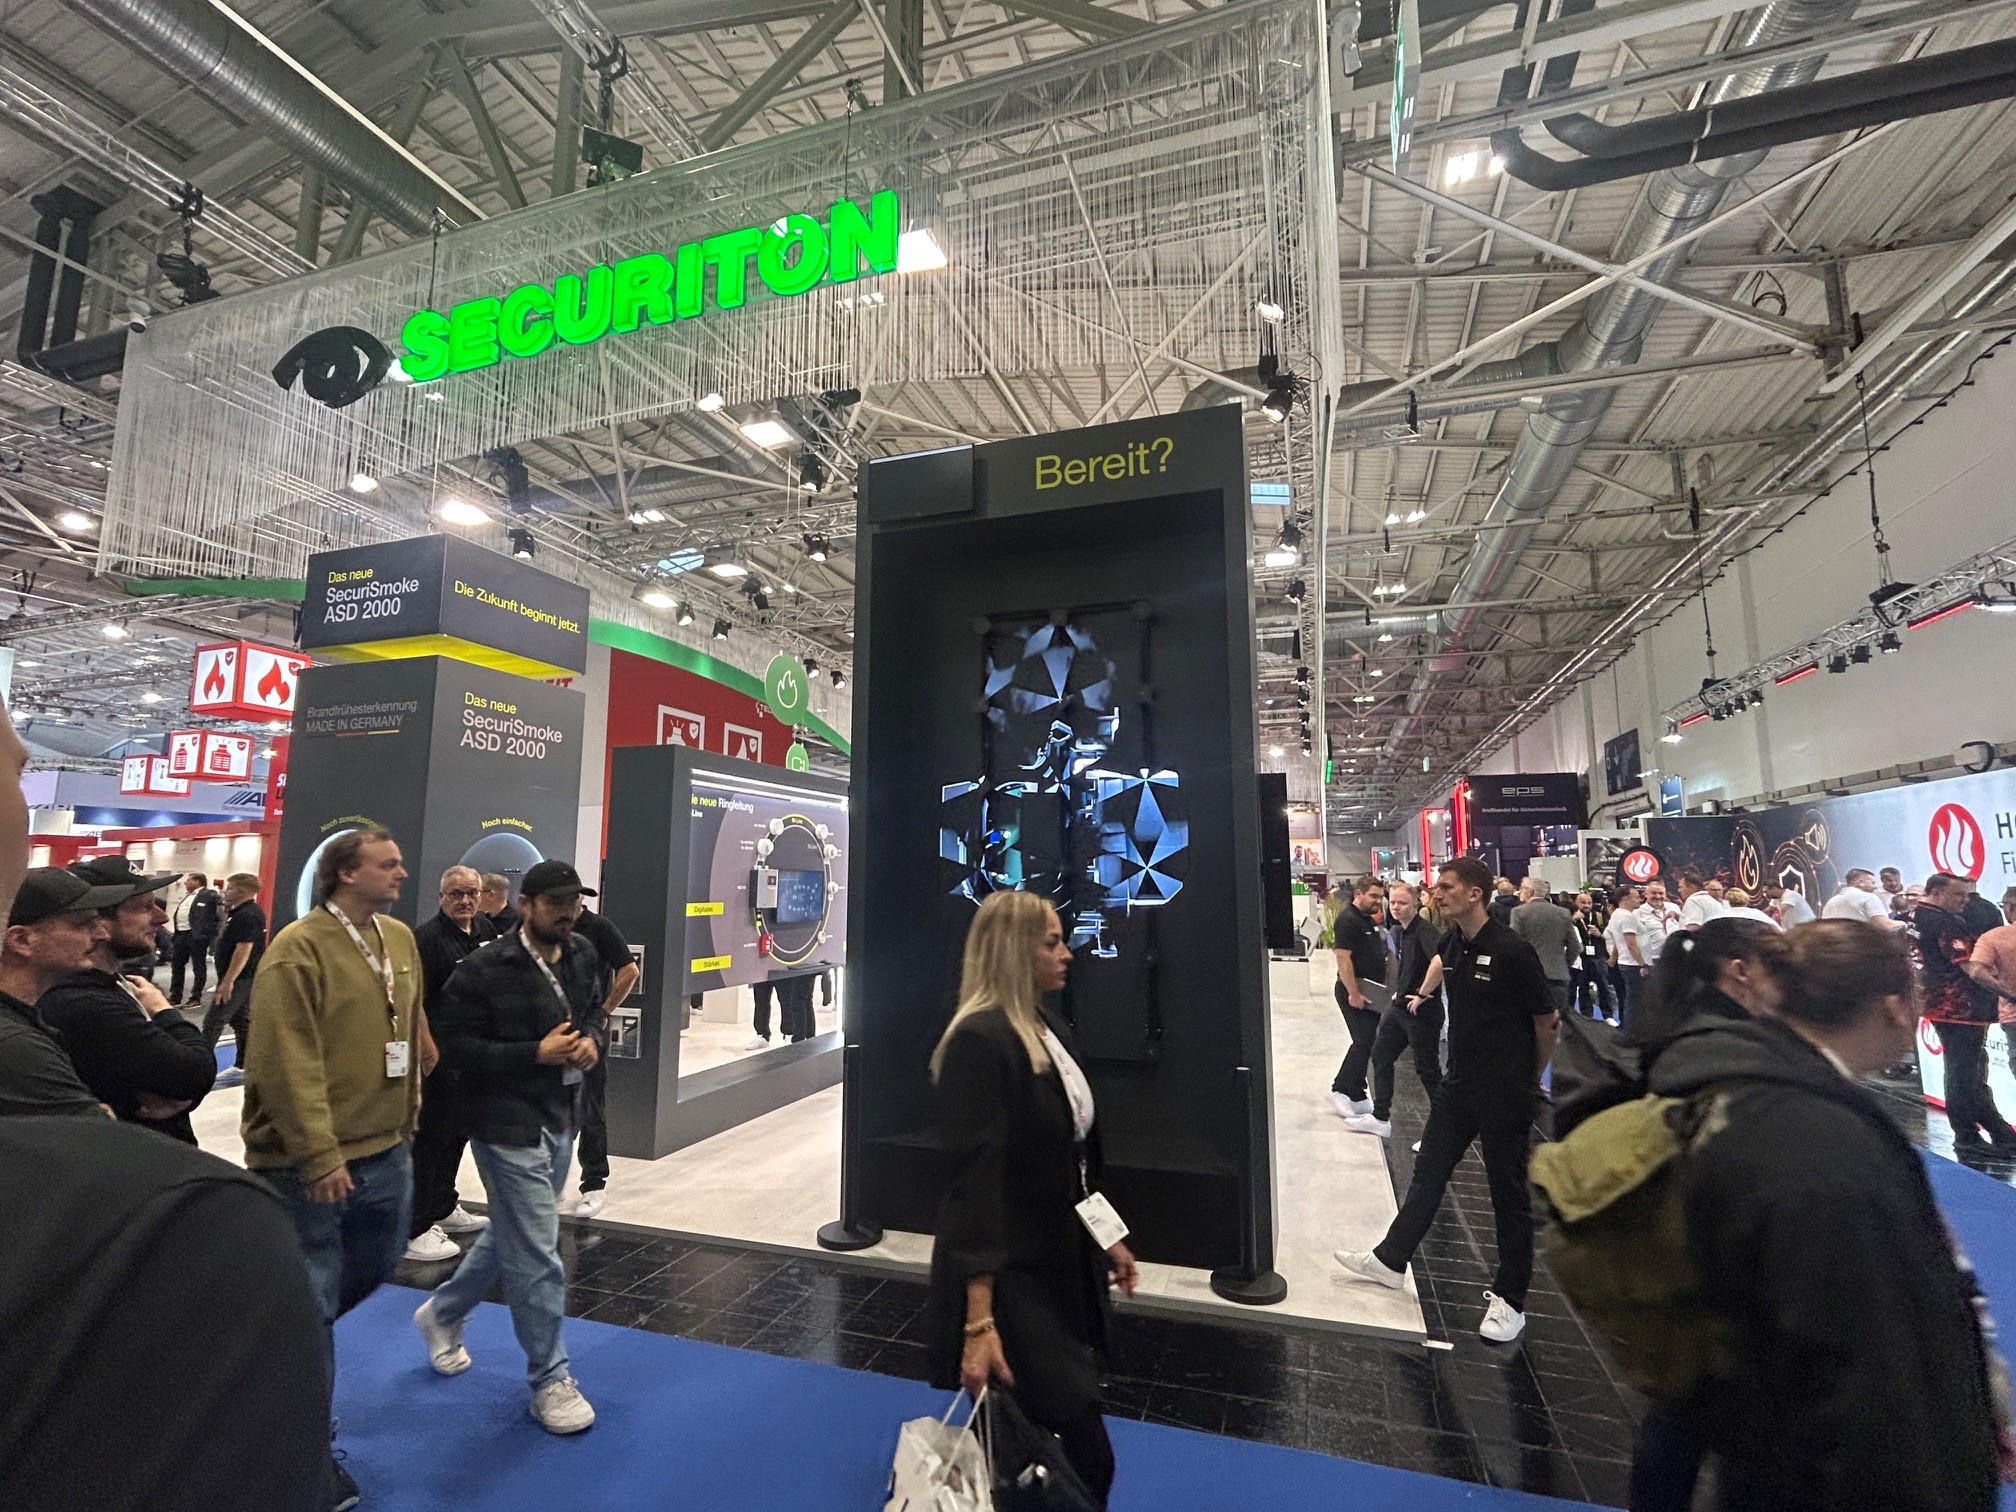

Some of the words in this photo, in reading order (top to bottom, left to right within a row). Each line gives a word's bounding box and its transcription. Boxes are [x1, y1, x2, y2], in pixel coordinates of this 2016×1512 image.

[399, 188, 899, 383] SECURITON
[1035, 437, 1174, 490] Bereit?
[328, 570, 347, 583] Das
[349, 567, 373, 581] neue
[326, 578, 419, 603] SecuriSmoke
[323, 602, 358, 624] ASD
[362, 597, 400, 619] 2000
[454, 580, 474, 598] Die
[476, 587, 518, 612] Zukunft
[520, 603, 557, 627] beginnt
[557, 614, 581, 634] jetzt.
[307, 699, 417, 719] Brandfrühesterkennung
[464, 692, 487, 708] Das
[490, 698, 517, 714] neue
[306, 718, 335, 733] MADE
[337, 717, 348, 731] IN
[350, 714, 404, 730] GERMANY
[462, 710, 563, 743] SecuriSmoke
[459, 729, 501, 752] ASD
[506, 739, 546, 760] 2000
[699, 797, 718, 808] neue
[481, 817, 501, 829] Noch
